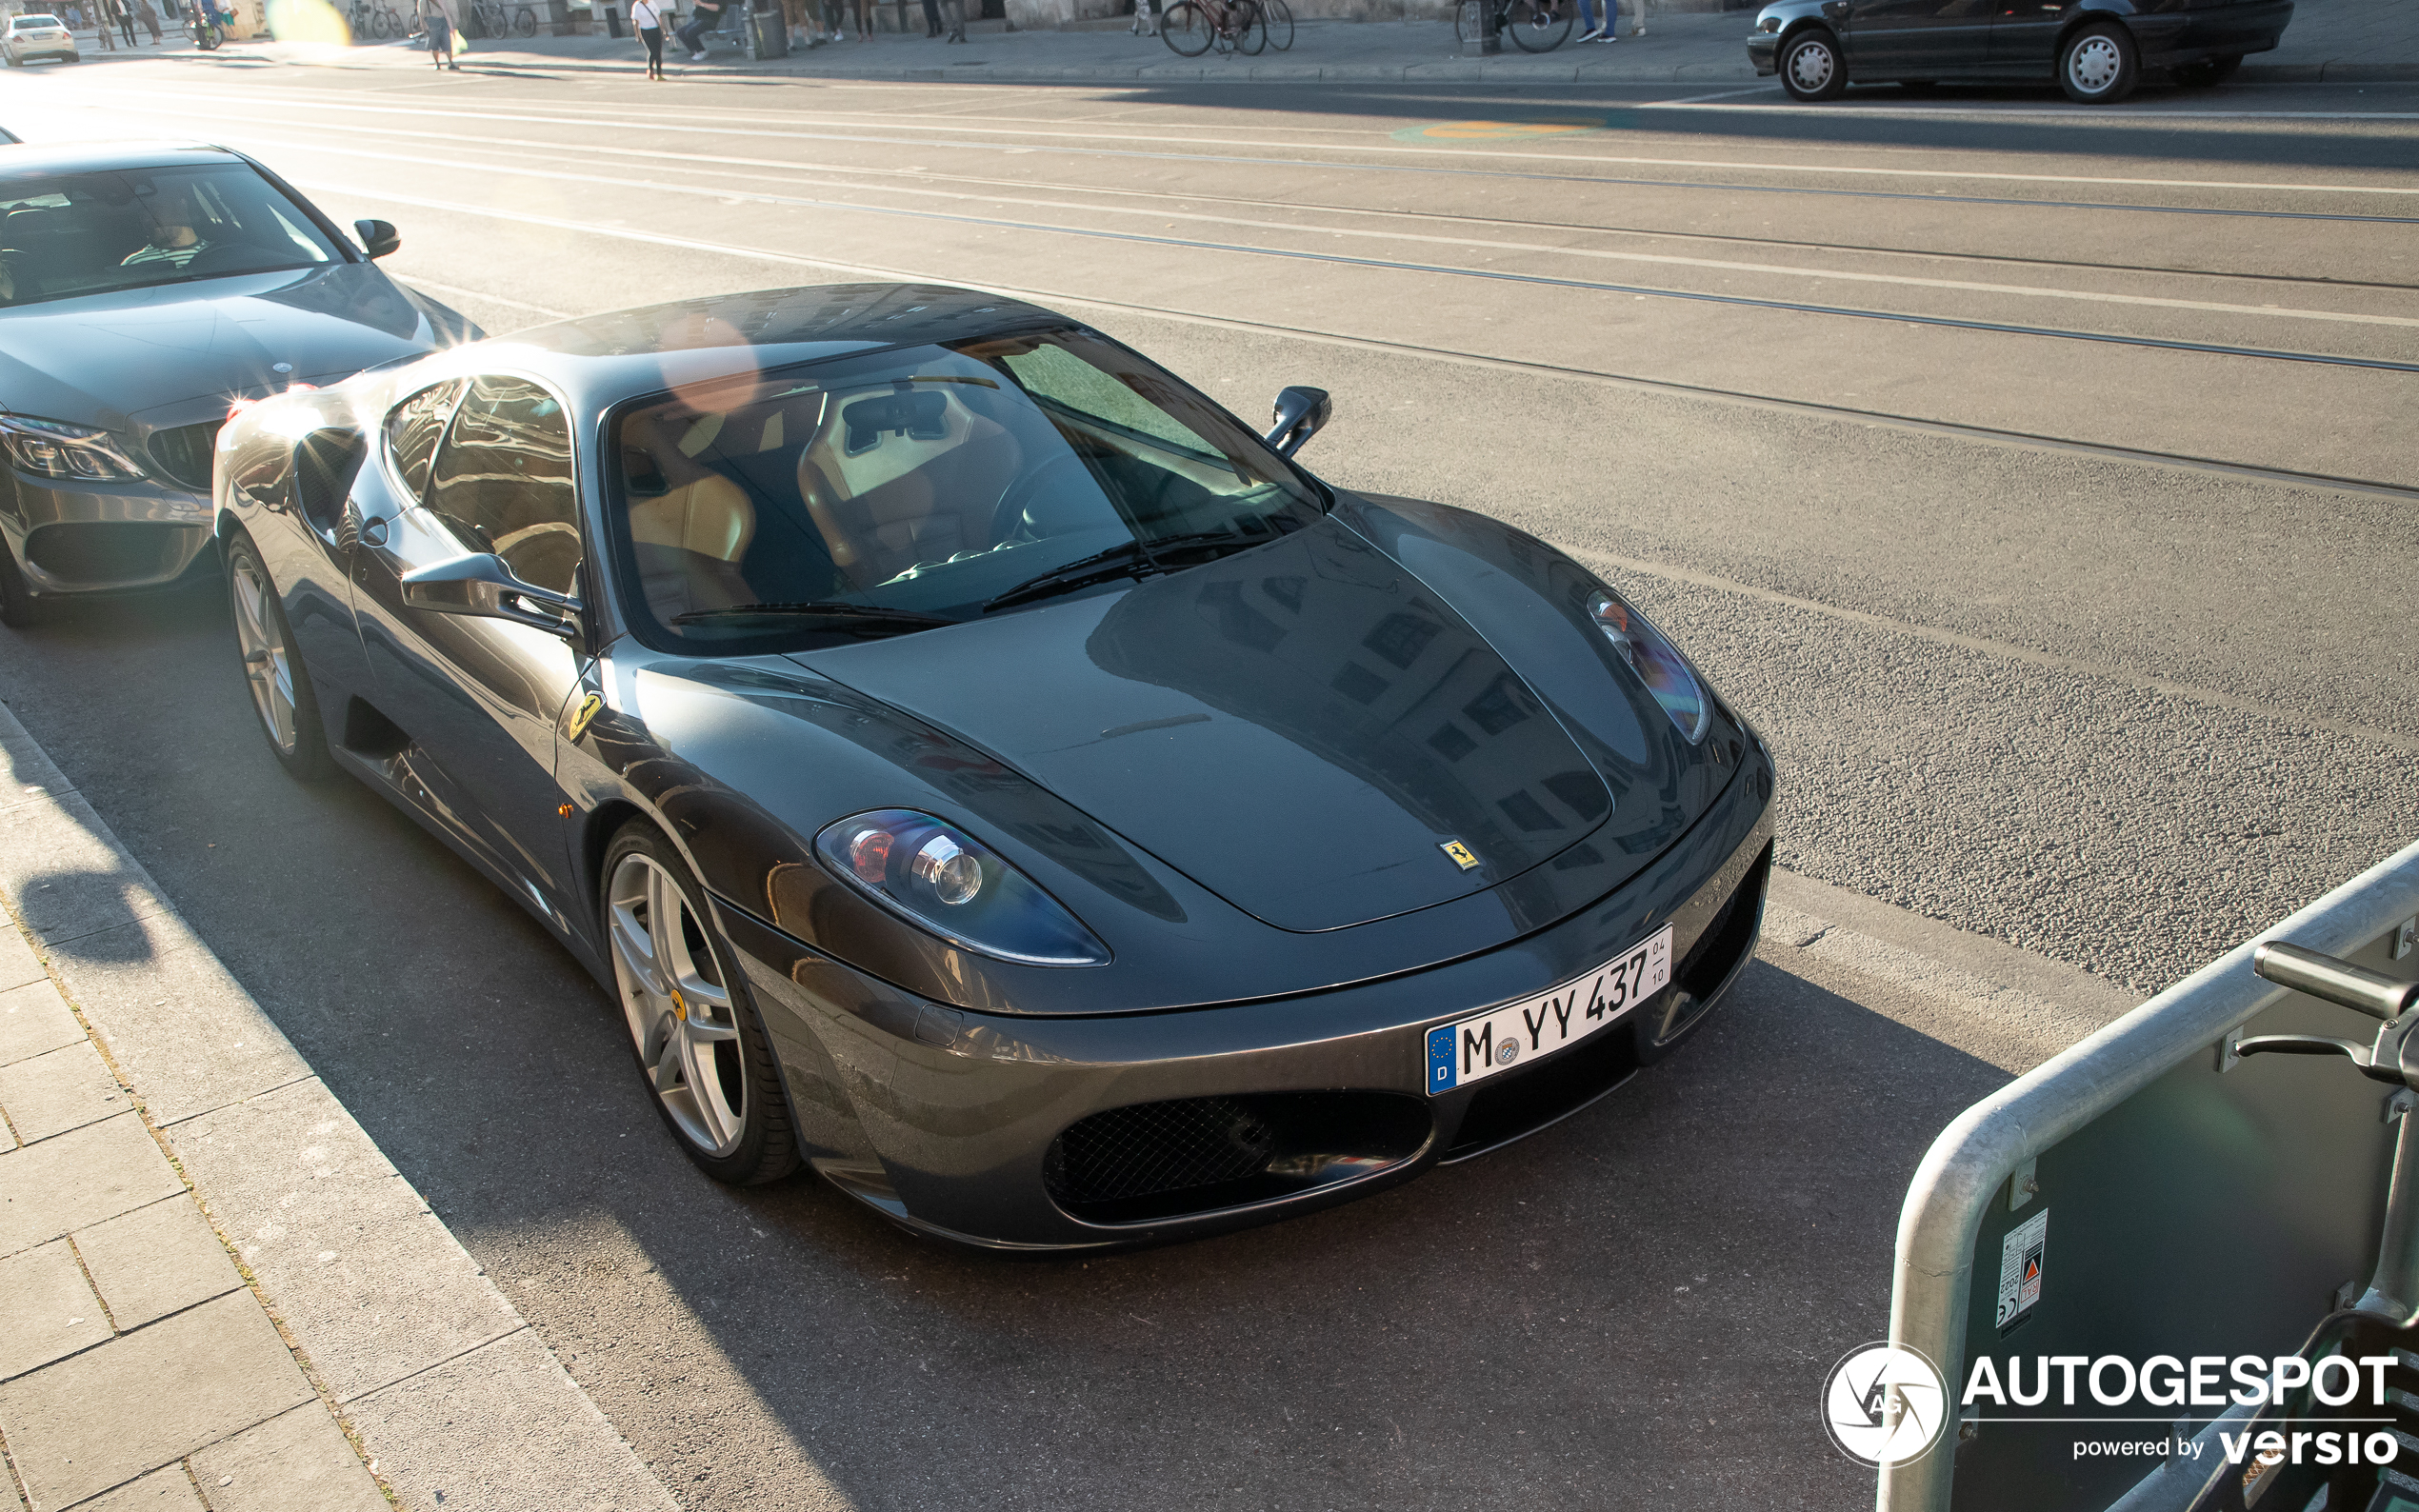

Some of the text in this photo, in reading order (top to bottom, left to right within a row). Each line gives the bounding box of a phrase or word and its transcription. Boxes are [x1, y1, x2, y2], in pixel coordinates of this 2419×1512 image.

[1652, 938, 1665, 955] 04
[1652, 968, 1664, 985] 10
[1464, 1021, 1491, 1075] M
[1523, 989, 1576, 1051] YY
[1586, 948, 1648, 1021] 437
[1437, 1065, 1448, 1081] D
[2000, 1275, 2019, 1294] 2022
[2022, 1282, 2039, 1299] RAL
[1997, 1298, 2017, 1325] CE
